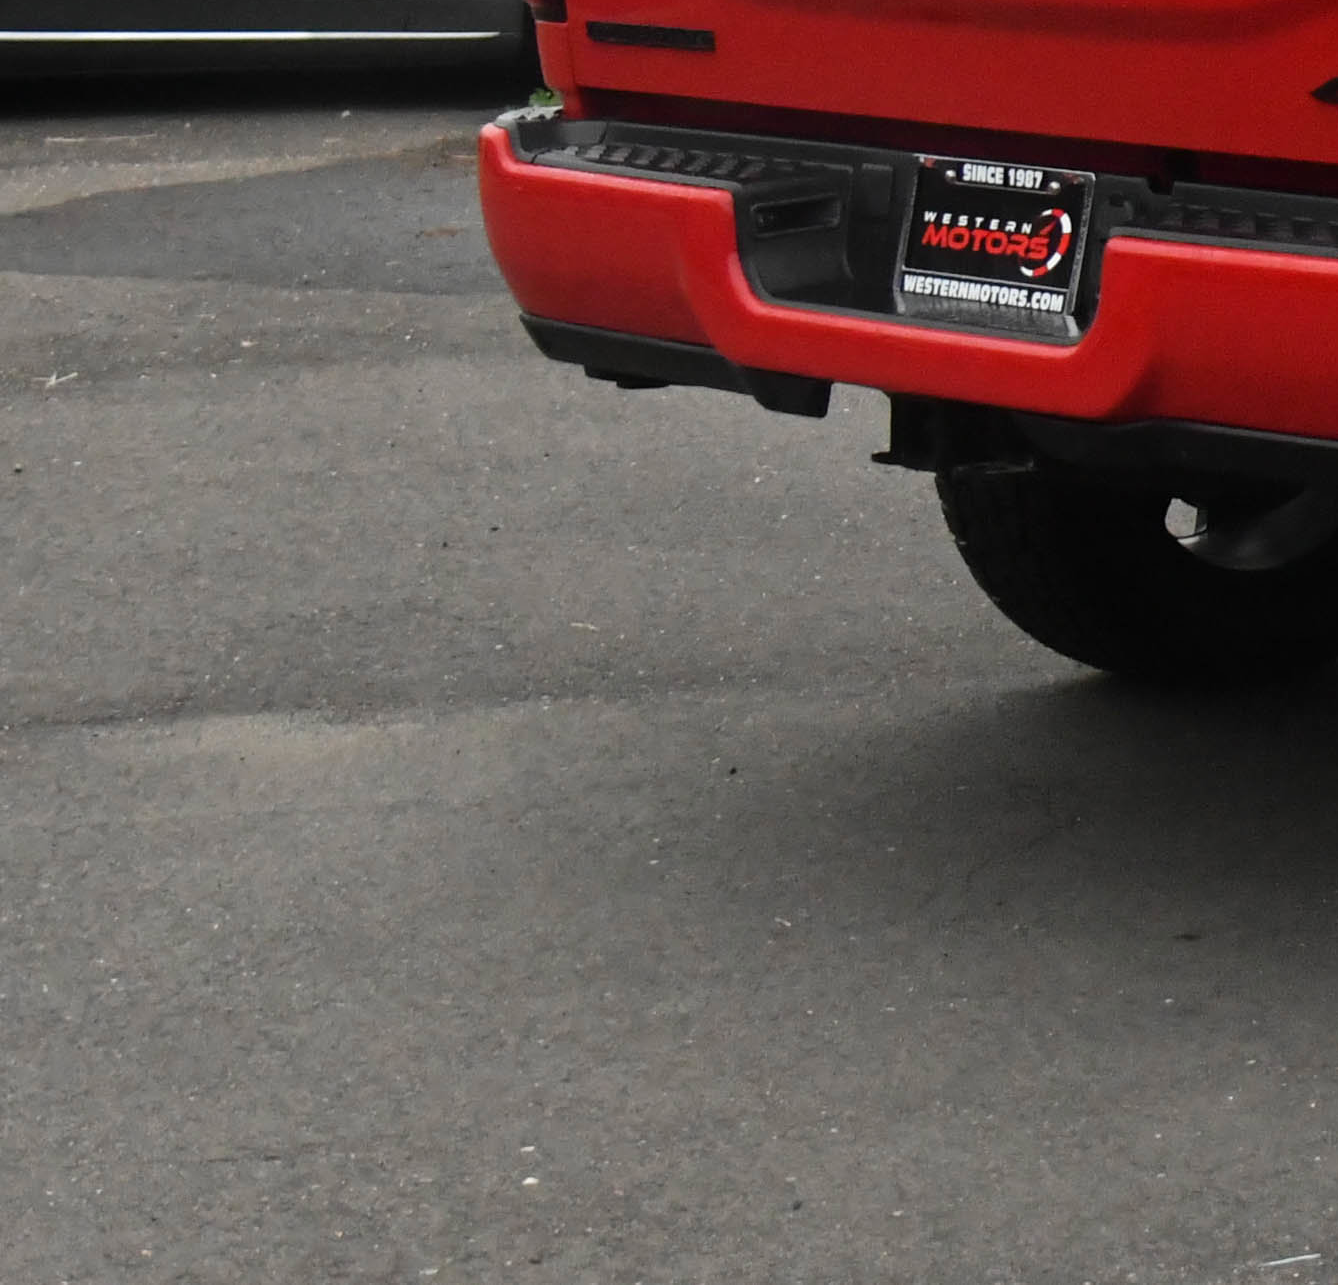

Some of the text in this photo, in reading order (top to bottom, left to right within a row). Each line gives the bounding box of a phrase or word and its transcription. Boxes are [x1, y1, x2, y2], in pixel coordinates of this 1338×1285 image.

[962, 163, 1044, 189] SINCE 1987
[923, 210, 1033, 234] WESTERN
[921, 223, 1050, 261] MOTORS
[903, 274, 1065, 313] WESTERNMOTORS.COM
